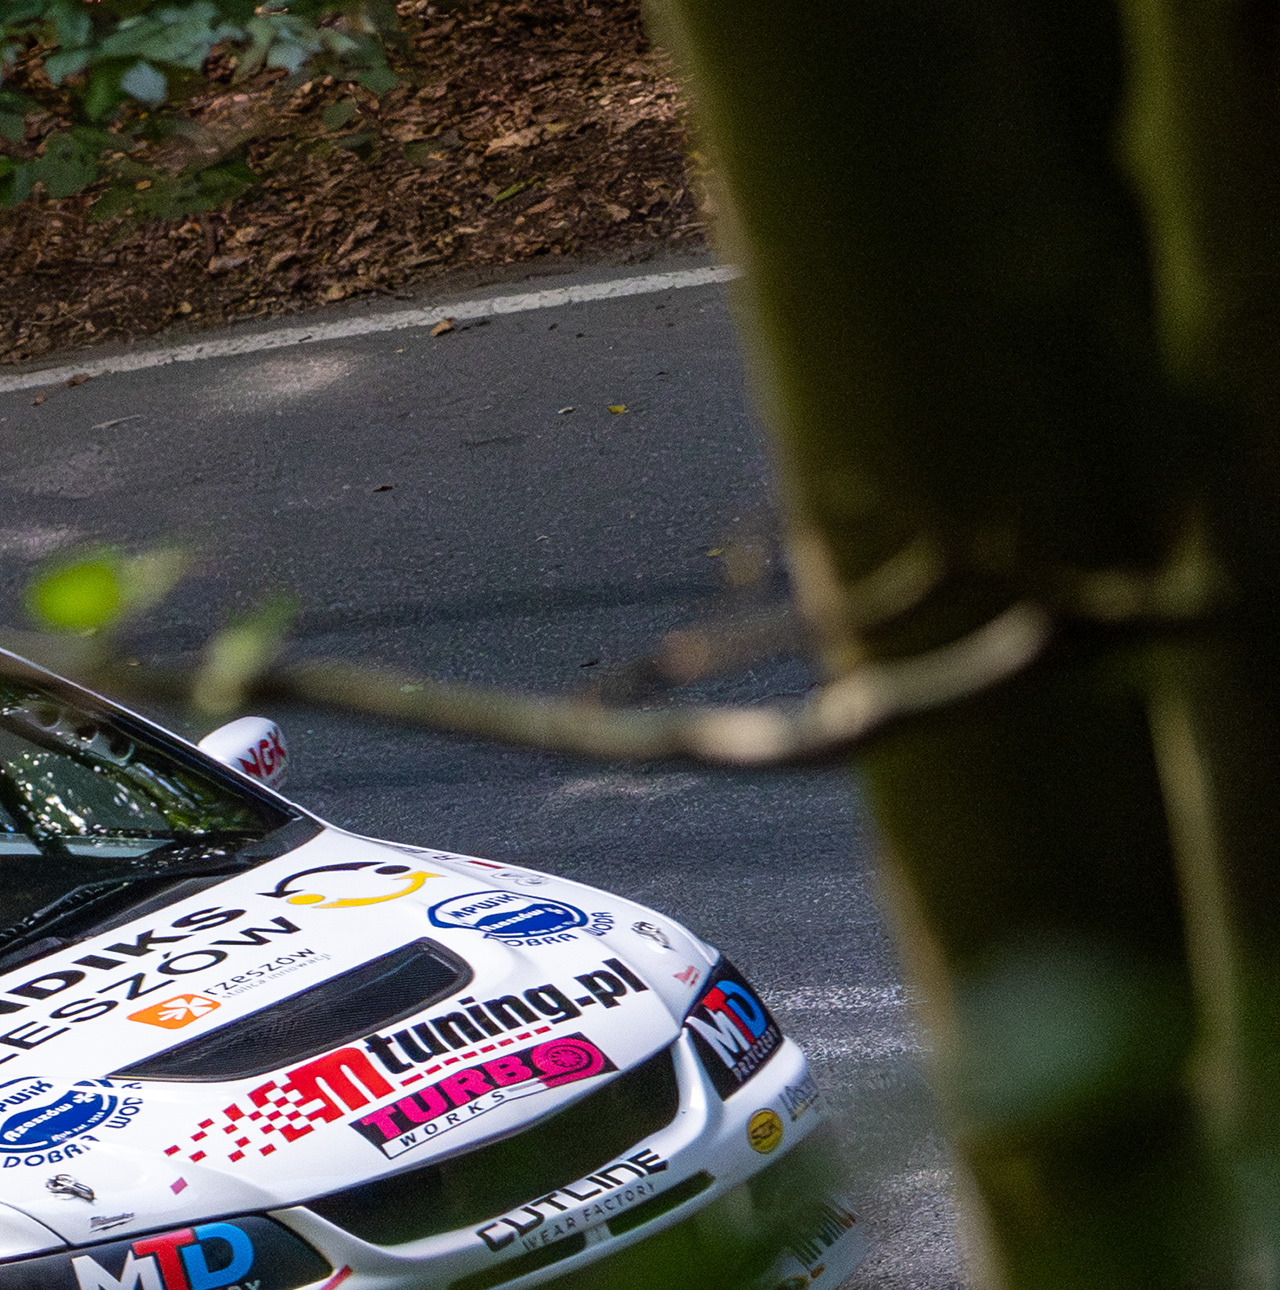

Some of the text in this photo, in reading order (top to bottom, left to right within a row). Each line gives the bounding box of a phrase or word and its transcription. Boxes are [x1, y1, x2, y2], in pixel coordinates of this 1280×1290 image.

[685, 980, 768, 1070] MTD
[400, 1090, 505, 1147] WORKS
[476, 1148, 670, 1252] CUTLINE
[583, 1181, 655, 1221] FACTORY
